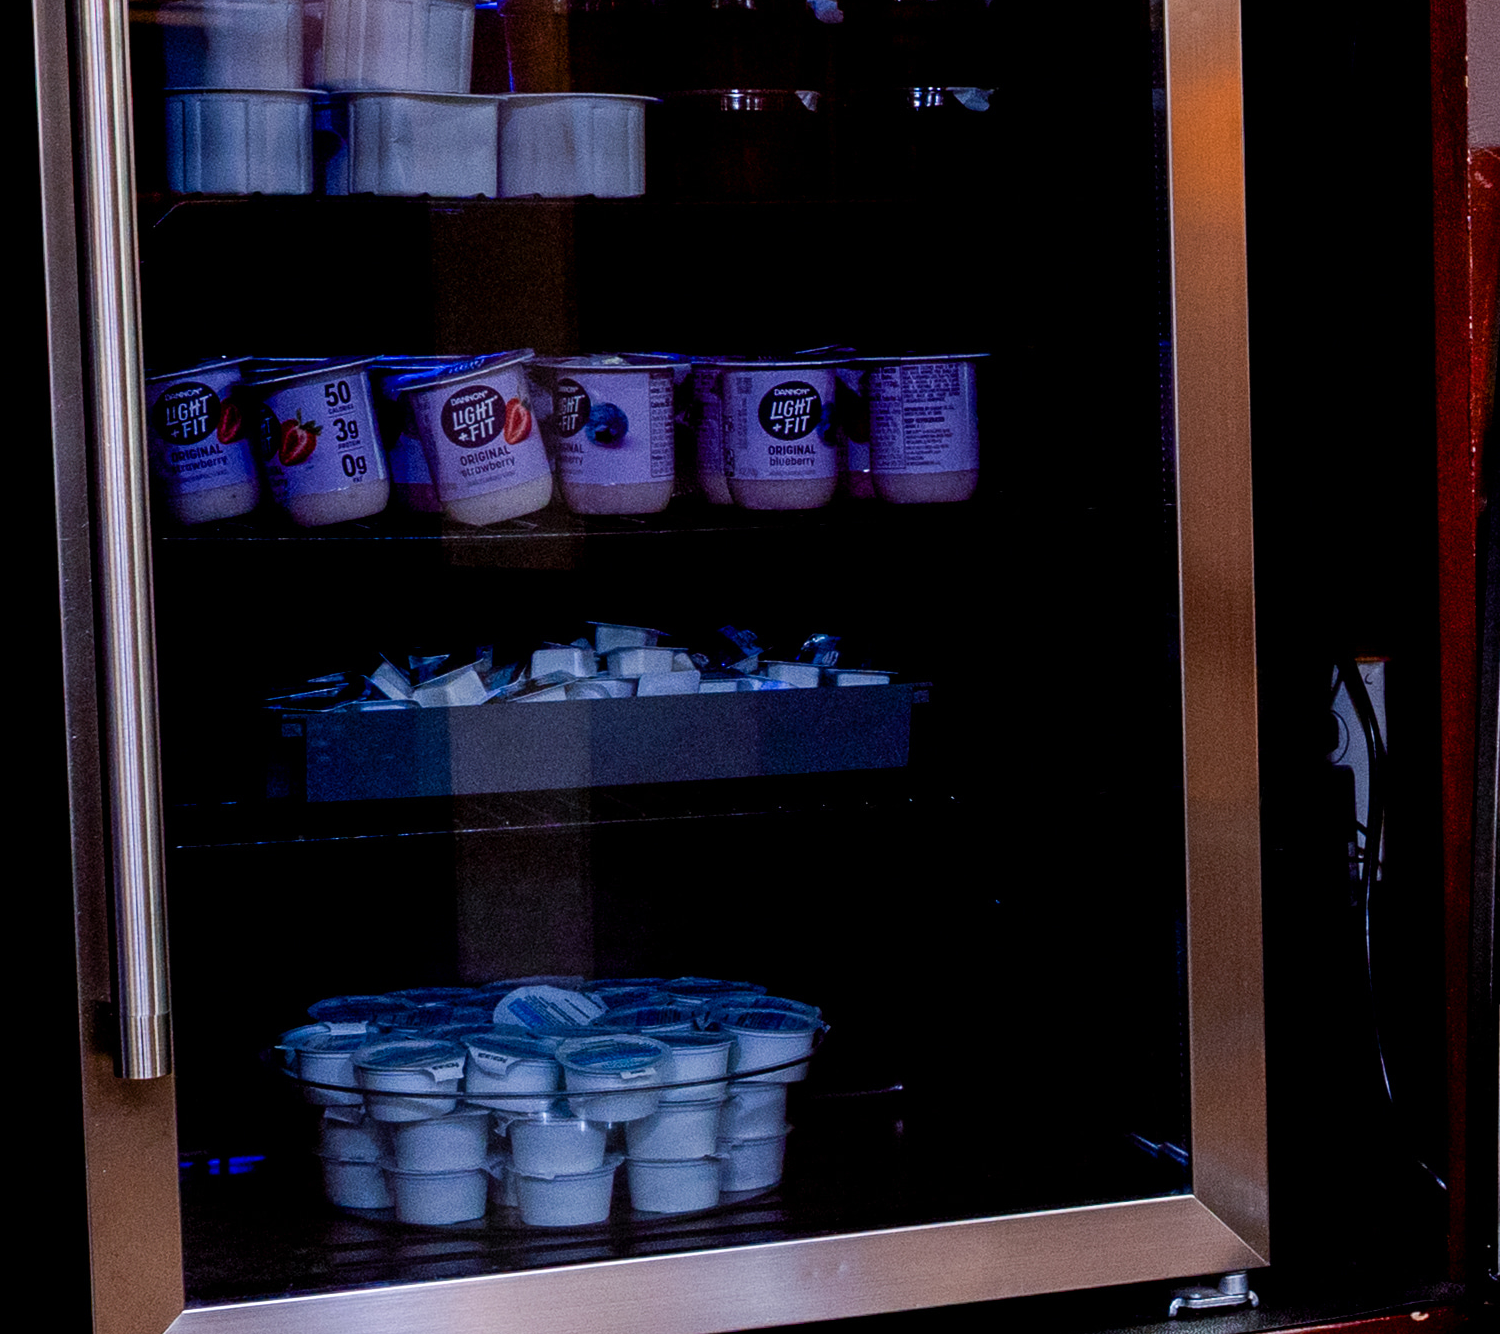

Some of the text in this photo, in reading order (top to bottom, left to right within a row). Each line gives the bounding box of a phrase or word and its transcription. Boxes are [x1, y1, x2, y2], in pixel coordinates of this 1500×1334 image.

[324, 380, 351, 407] 50
[450, 390, 487, 407] DANNON
[773, 387, 810, 397] DANNON
[166, 395, 209, 426] LIGHT
[452, 397, 496, 431] LIGHT
[559, 394, 585, 416] GHT
[770, 397, 814, 421] LIGHT
[333, 418, 359, 442] 3g
[171, 444, 223, 463] ORIGINAL
[459, 445, 511, 466] ORIGINAL
[768, 445, 816, 456] ORIGINAL
[342, 453, 368, 478] 0g
[461, 456, 515, 478] strawberry
[769, 457, 815, 467] blueberry
